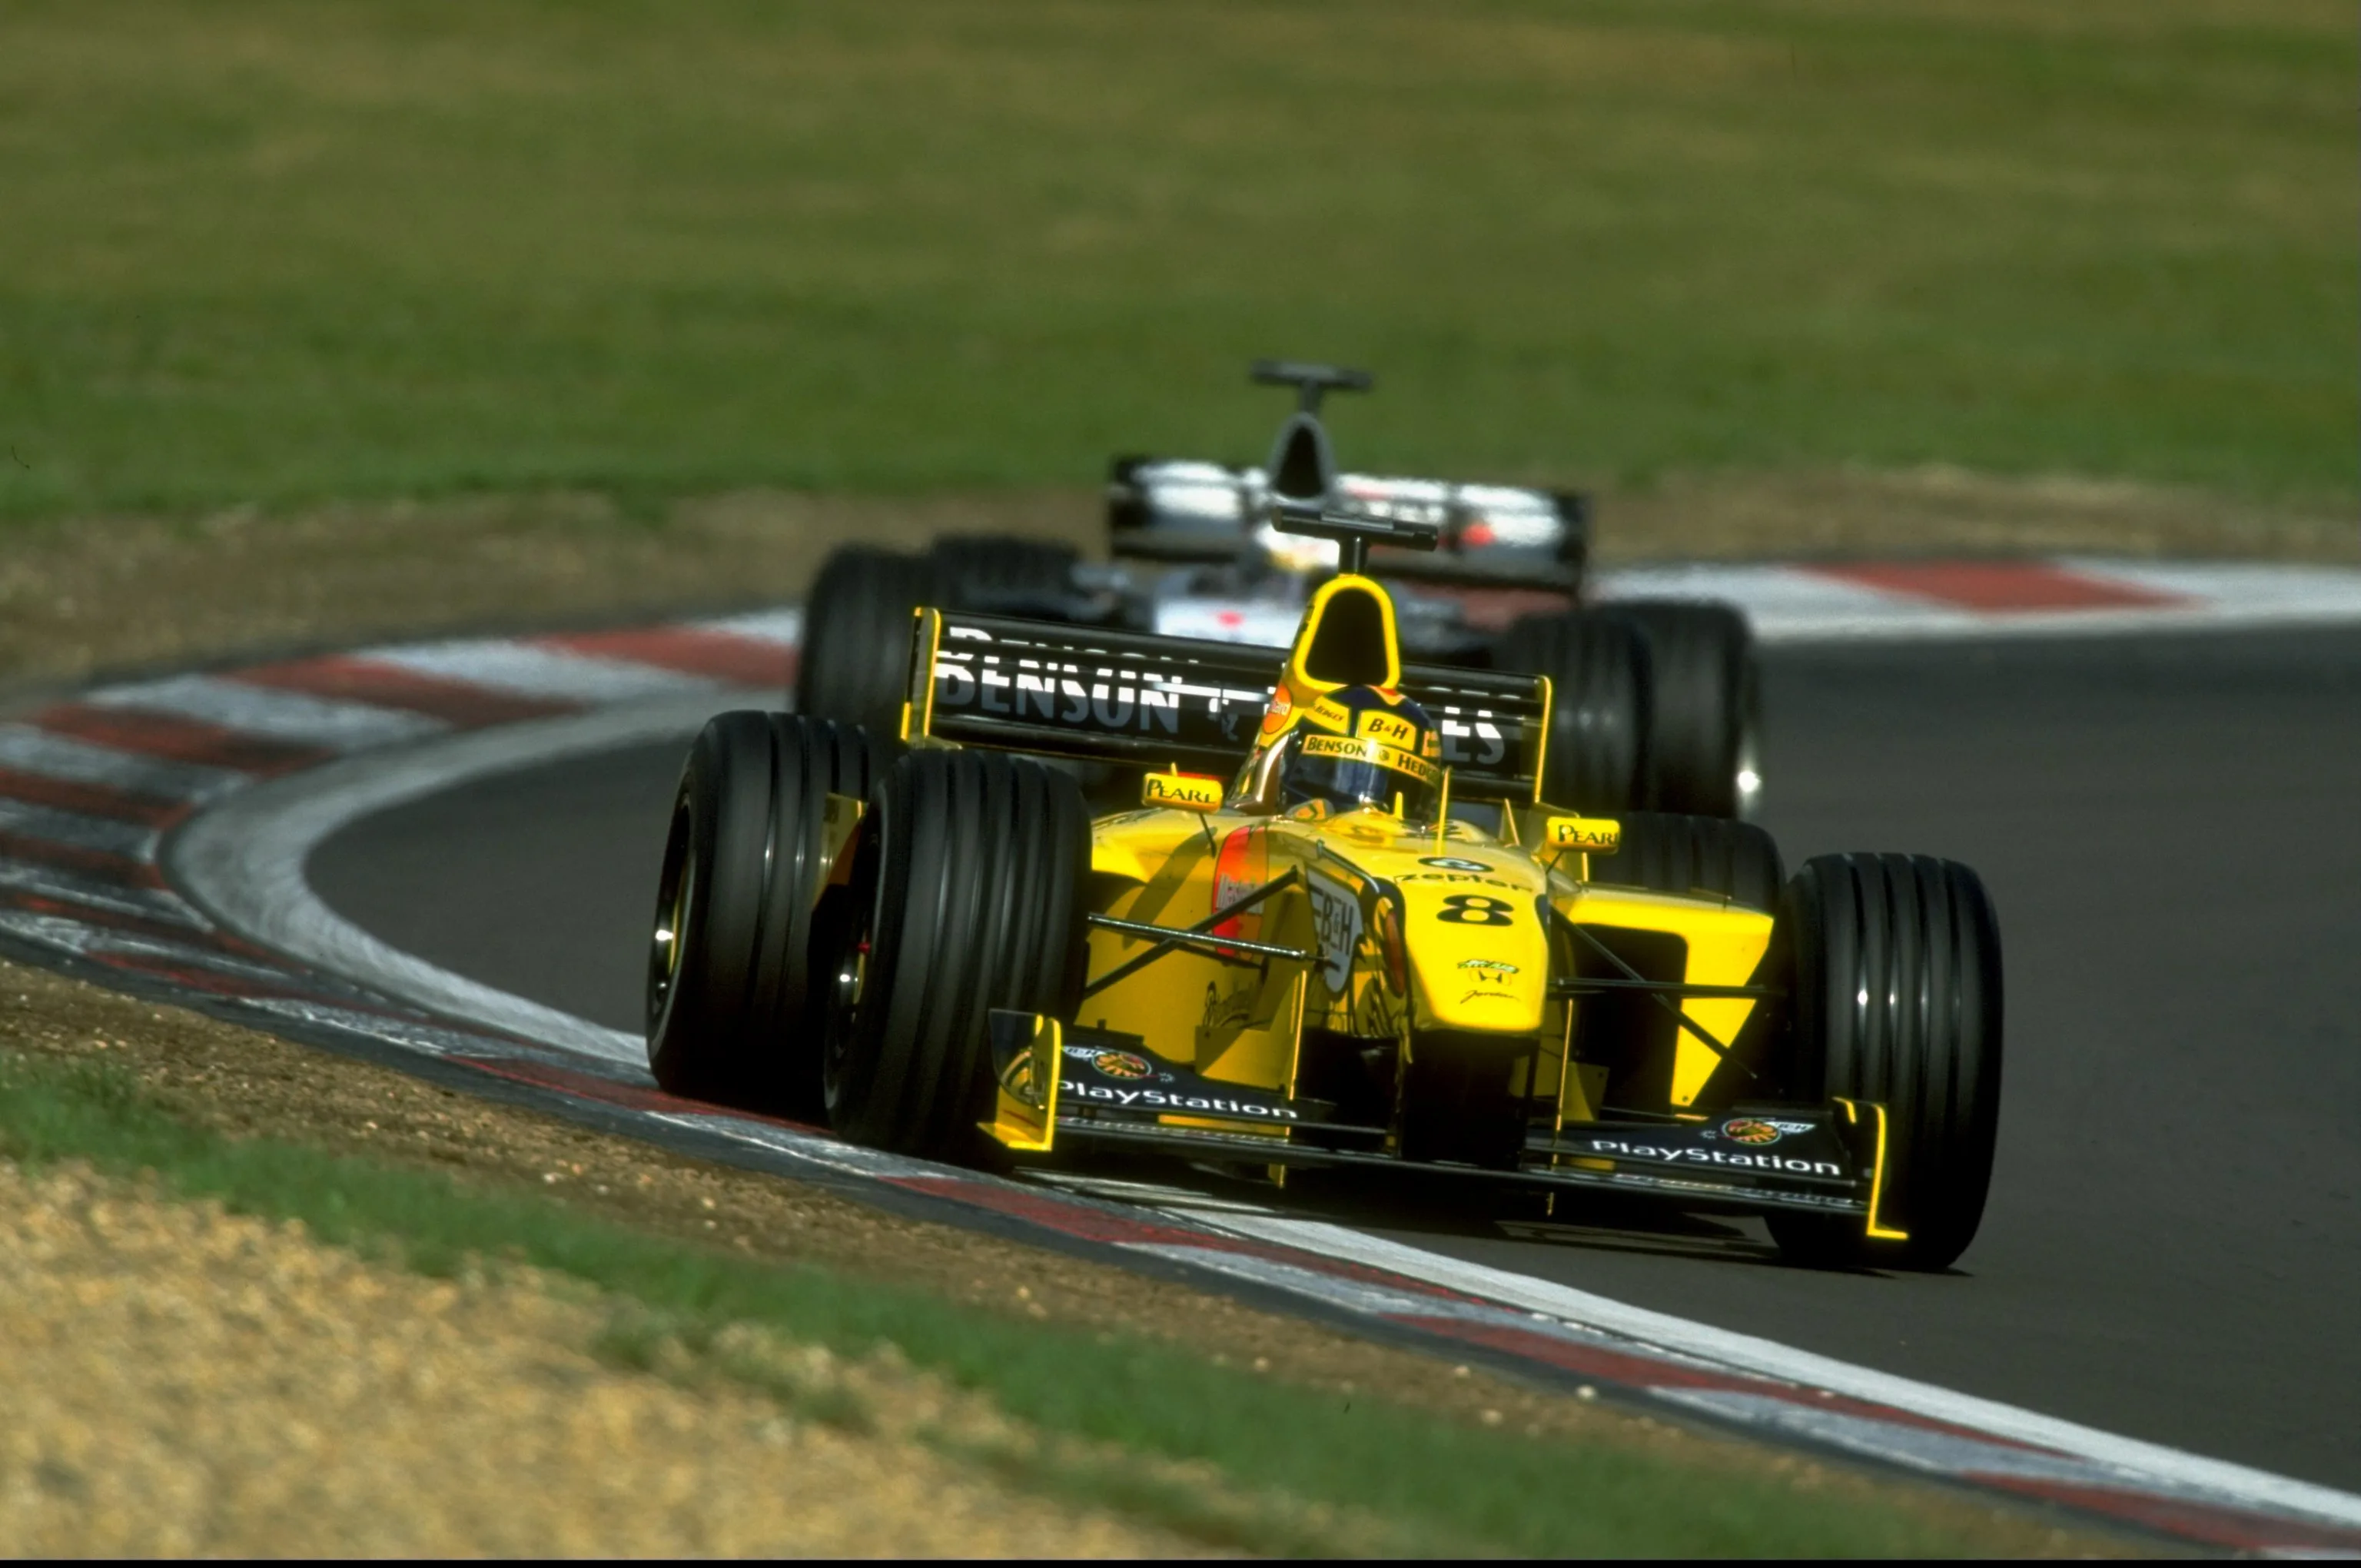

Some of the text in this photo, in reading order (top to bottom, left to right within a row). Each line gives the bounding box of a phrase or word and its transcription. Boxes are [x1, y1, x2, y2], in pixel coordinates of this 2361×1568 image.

[1307, 736, 1367, 758] BENSON
[1436, 894, 1515, 926] 8
[1058, 1080, 1298, 1119] PlayStation
[1592, 1140, 1841, 1176] PlayStation
